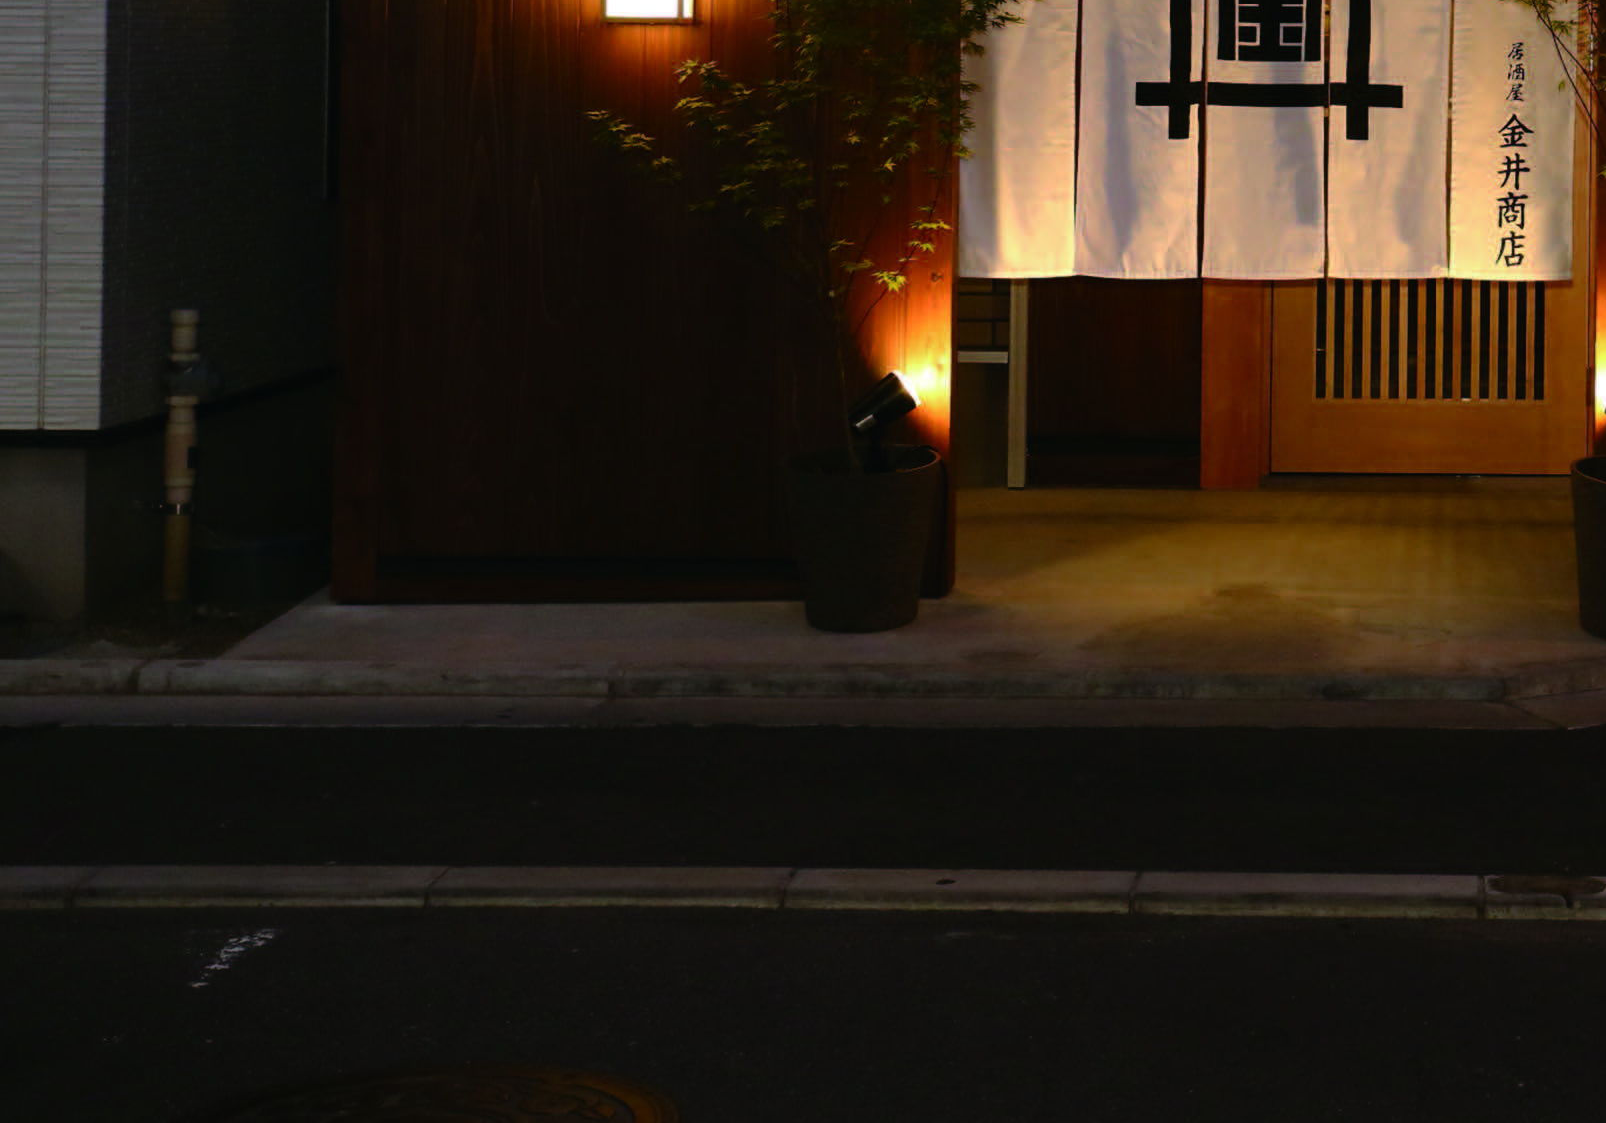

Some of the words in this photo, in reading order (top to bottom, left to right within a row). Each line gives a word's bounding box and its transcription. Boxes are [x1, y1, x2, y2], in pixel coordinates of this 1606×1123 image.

[1506, 42, 1526, 102] 居酒屋
[1495, 113, 1535, 267] 金井商店
